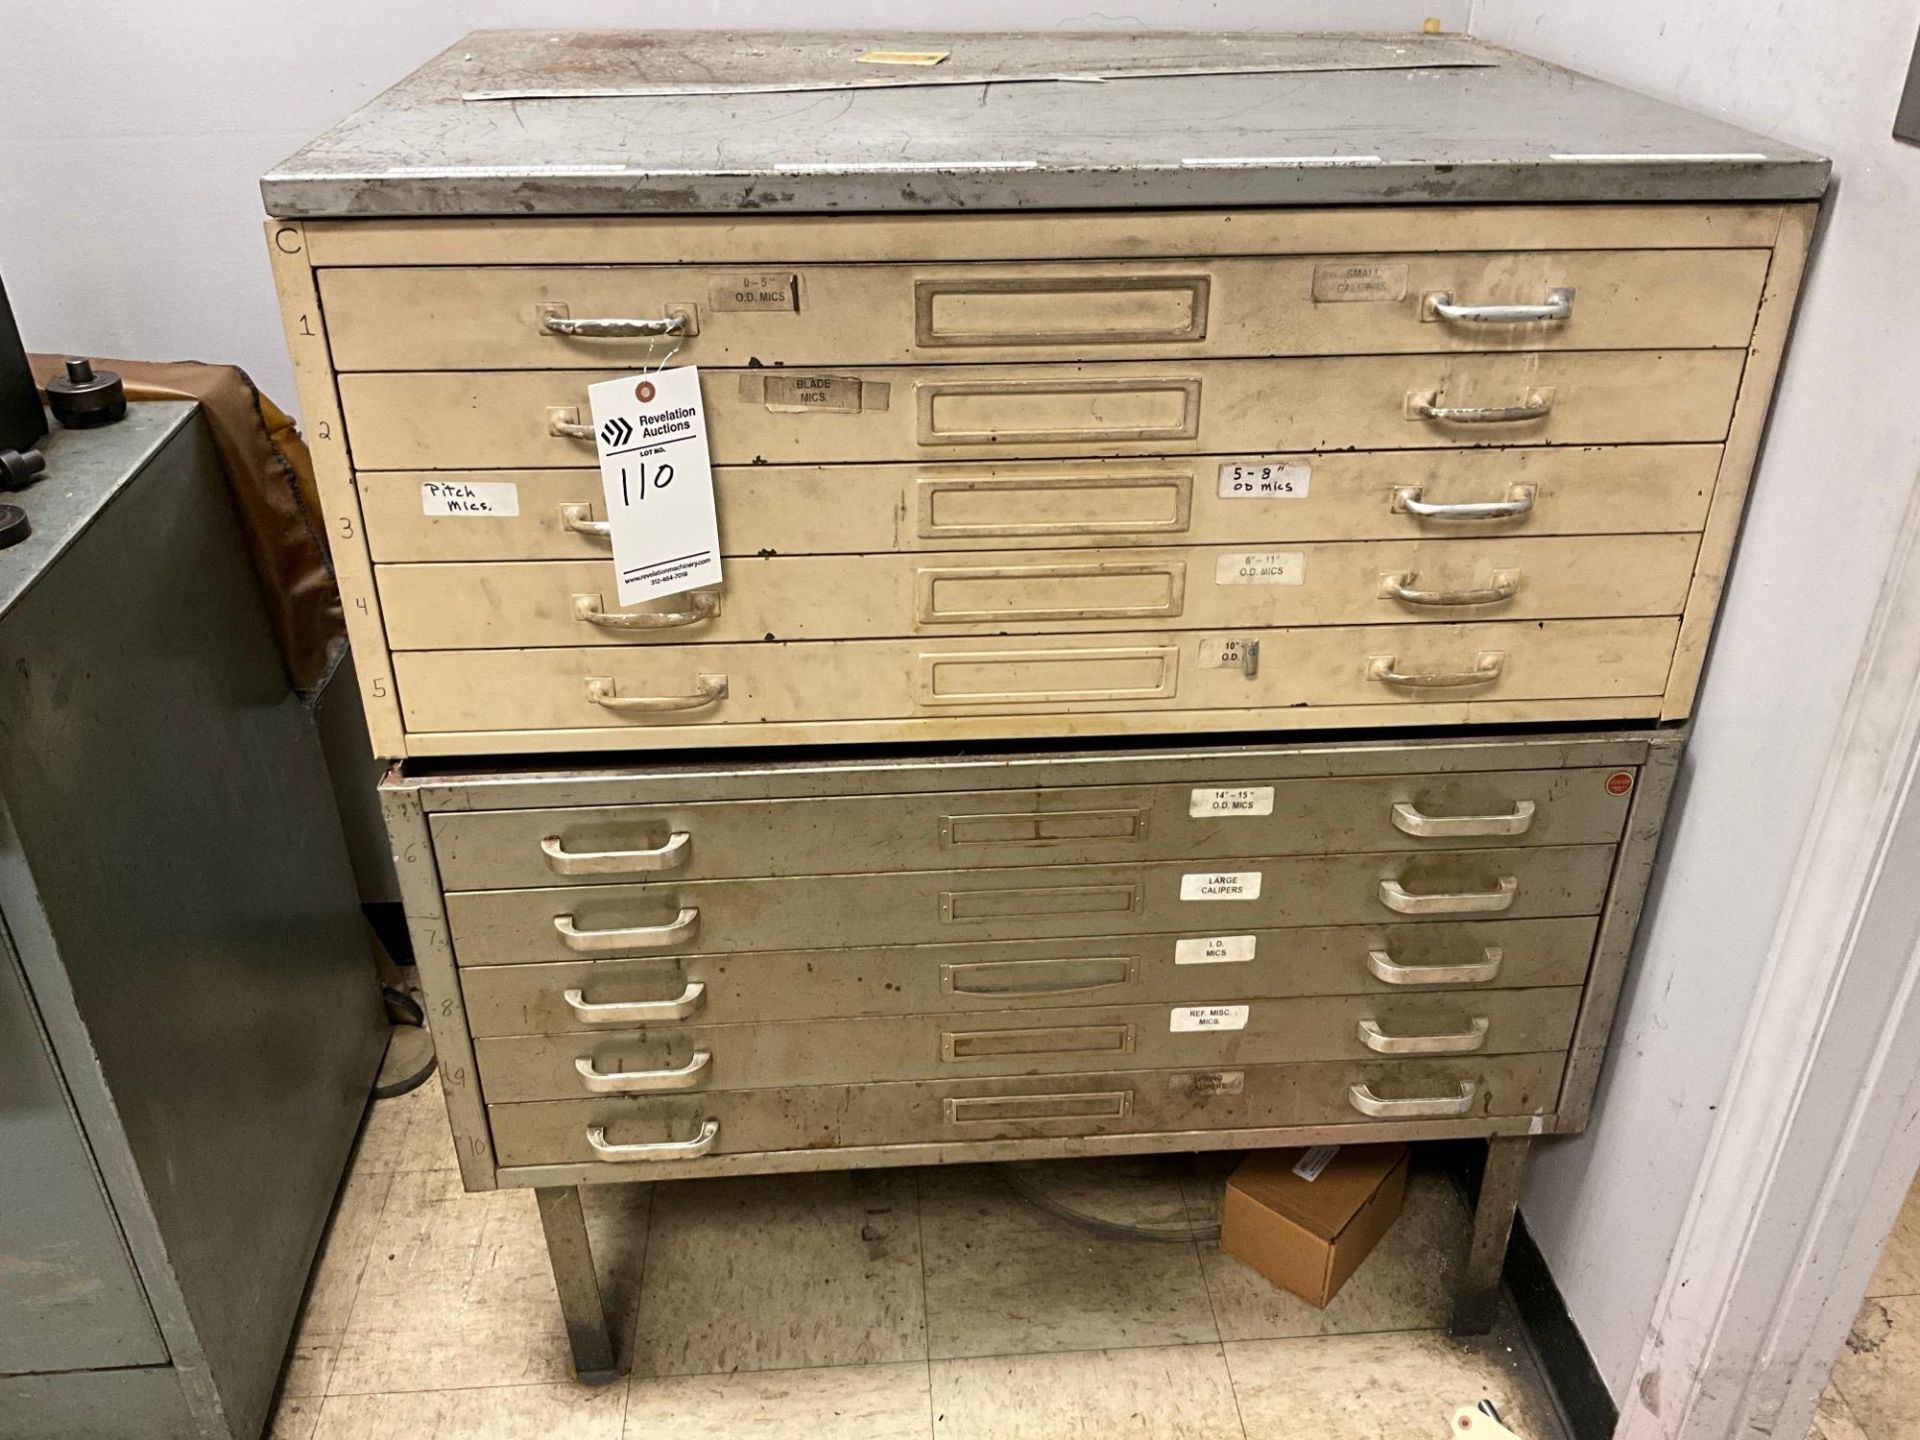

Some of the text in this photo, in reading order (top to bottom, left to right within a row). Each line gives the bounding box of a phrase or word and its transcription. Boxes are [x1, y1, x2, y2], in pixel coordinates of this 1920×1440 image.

[275, 227, 302, 255] C
[735, 291, 786, 303] O.D. MICS
[299, 314, 315, 337] 1
[796, 378, 831, 389] BLADE
[639, 406, 696, 426] Revelation
[318, 421, 331, 441] 2
[642, 420, 691, 439] Auctions
[639, 447, 666, 457] LOT NO.
[424, 482, 476, 498] Pitch
[621, 462, 674, 507] 110
[338, 517, 354, 540] 3
[1239, 566, 1284, 577] O.D. MICS
[355, 597, 369, 616] 4
[1221, 652, 1240, 662] O.D.
[372, 677, 387, 698] 5
[1212, 801, 1254, 809] O.D. MICS
[403, 842, 418, 864] 6
[1201, 886, 1243, 894] CALIPERS
[1208, 876, 1239, 885] LARGE
[423, 928, 437, 946] 7
[441, 998, 454, 1017] 8
[469, 1135, 486, 1157] 10
